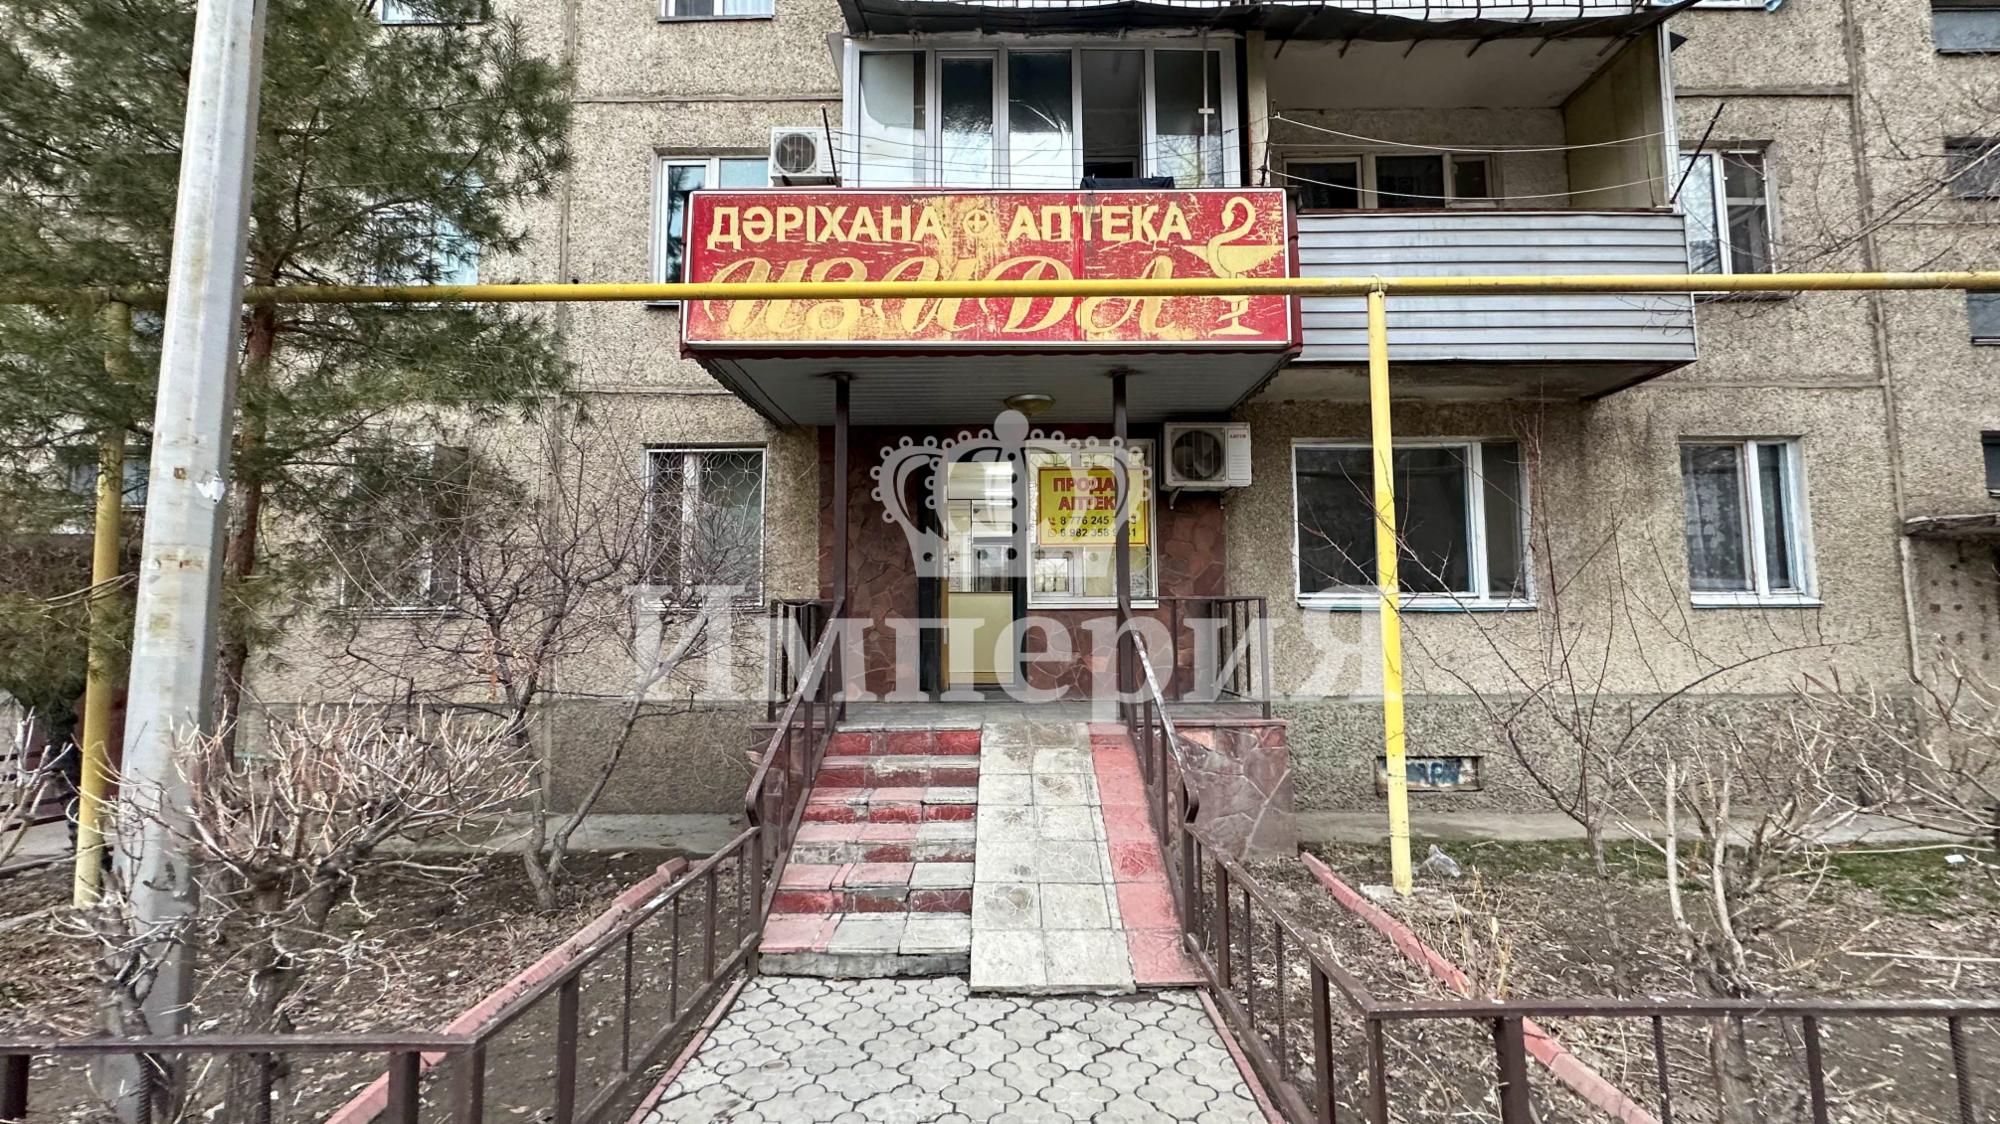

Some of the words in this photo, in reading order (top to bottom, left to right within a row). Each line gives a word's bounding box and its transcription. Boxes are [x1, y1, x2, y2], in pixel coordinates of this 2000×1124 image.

[706, 206, 947, 250] ДӘРІХАНА
[1007, 203, 1192, 242] АПТЕКА
[1053, 477, 1125, 495] ПРОДА
[1058, 496, 1125, 511] АПТЕК
[1060, 517, 1067, 526] 8
[1069, 516, 1088, 526] 776
[1091, 516, 1110, 526] 245
[1070, 528, 1088, 538] 982
